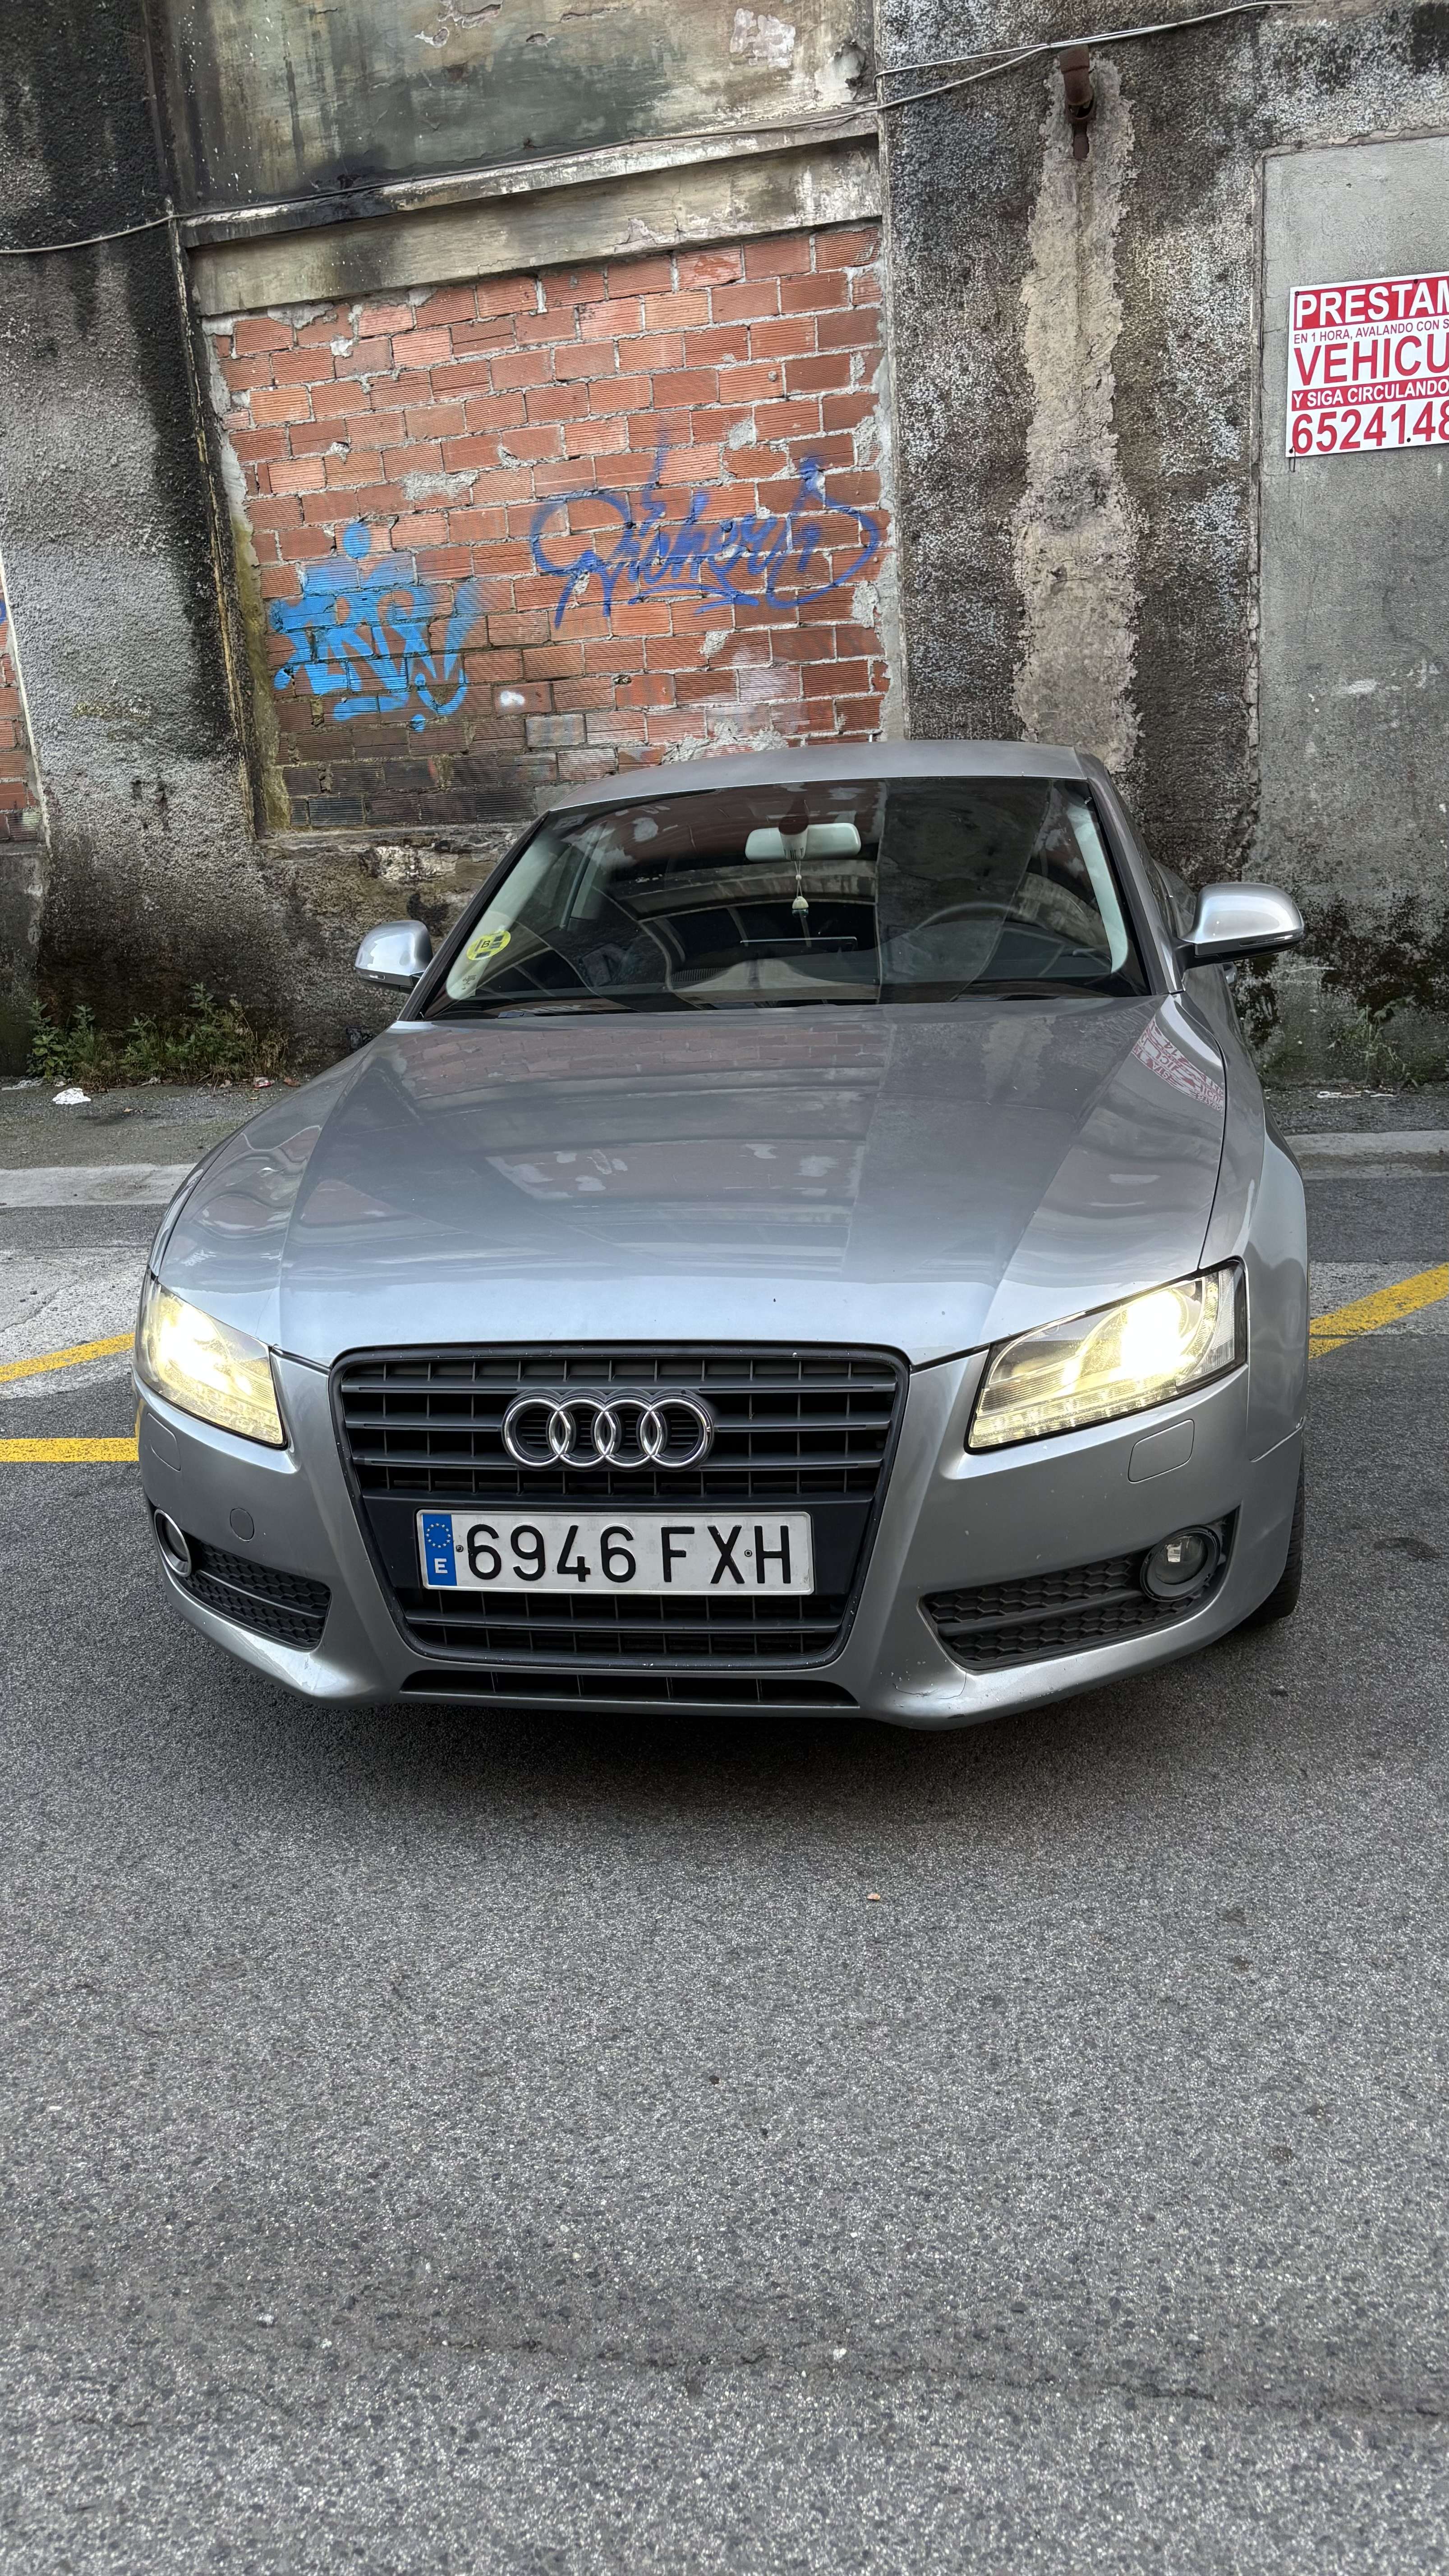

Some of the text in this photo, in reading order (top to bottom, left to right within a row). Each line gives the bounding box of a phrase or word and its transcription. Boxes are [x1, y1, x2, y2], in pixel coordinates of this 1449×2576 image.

[1294, 333, 1307, 344] EN
[1311, 332, 1316, 342] 1
[1320, 329, 1352, 341] HORA,
[1355, 322, 1413, 338] AVALANDO
[1417, 319, 1440, 331] CON
[1293, 332, 1449, 386] VEHICU
[1293, 378, 1449, 408] Y SIGA CIRCULANDO
[434, 1558, 448, 1574] E
[467, 1523, 791, 1584] 6946 FXH
